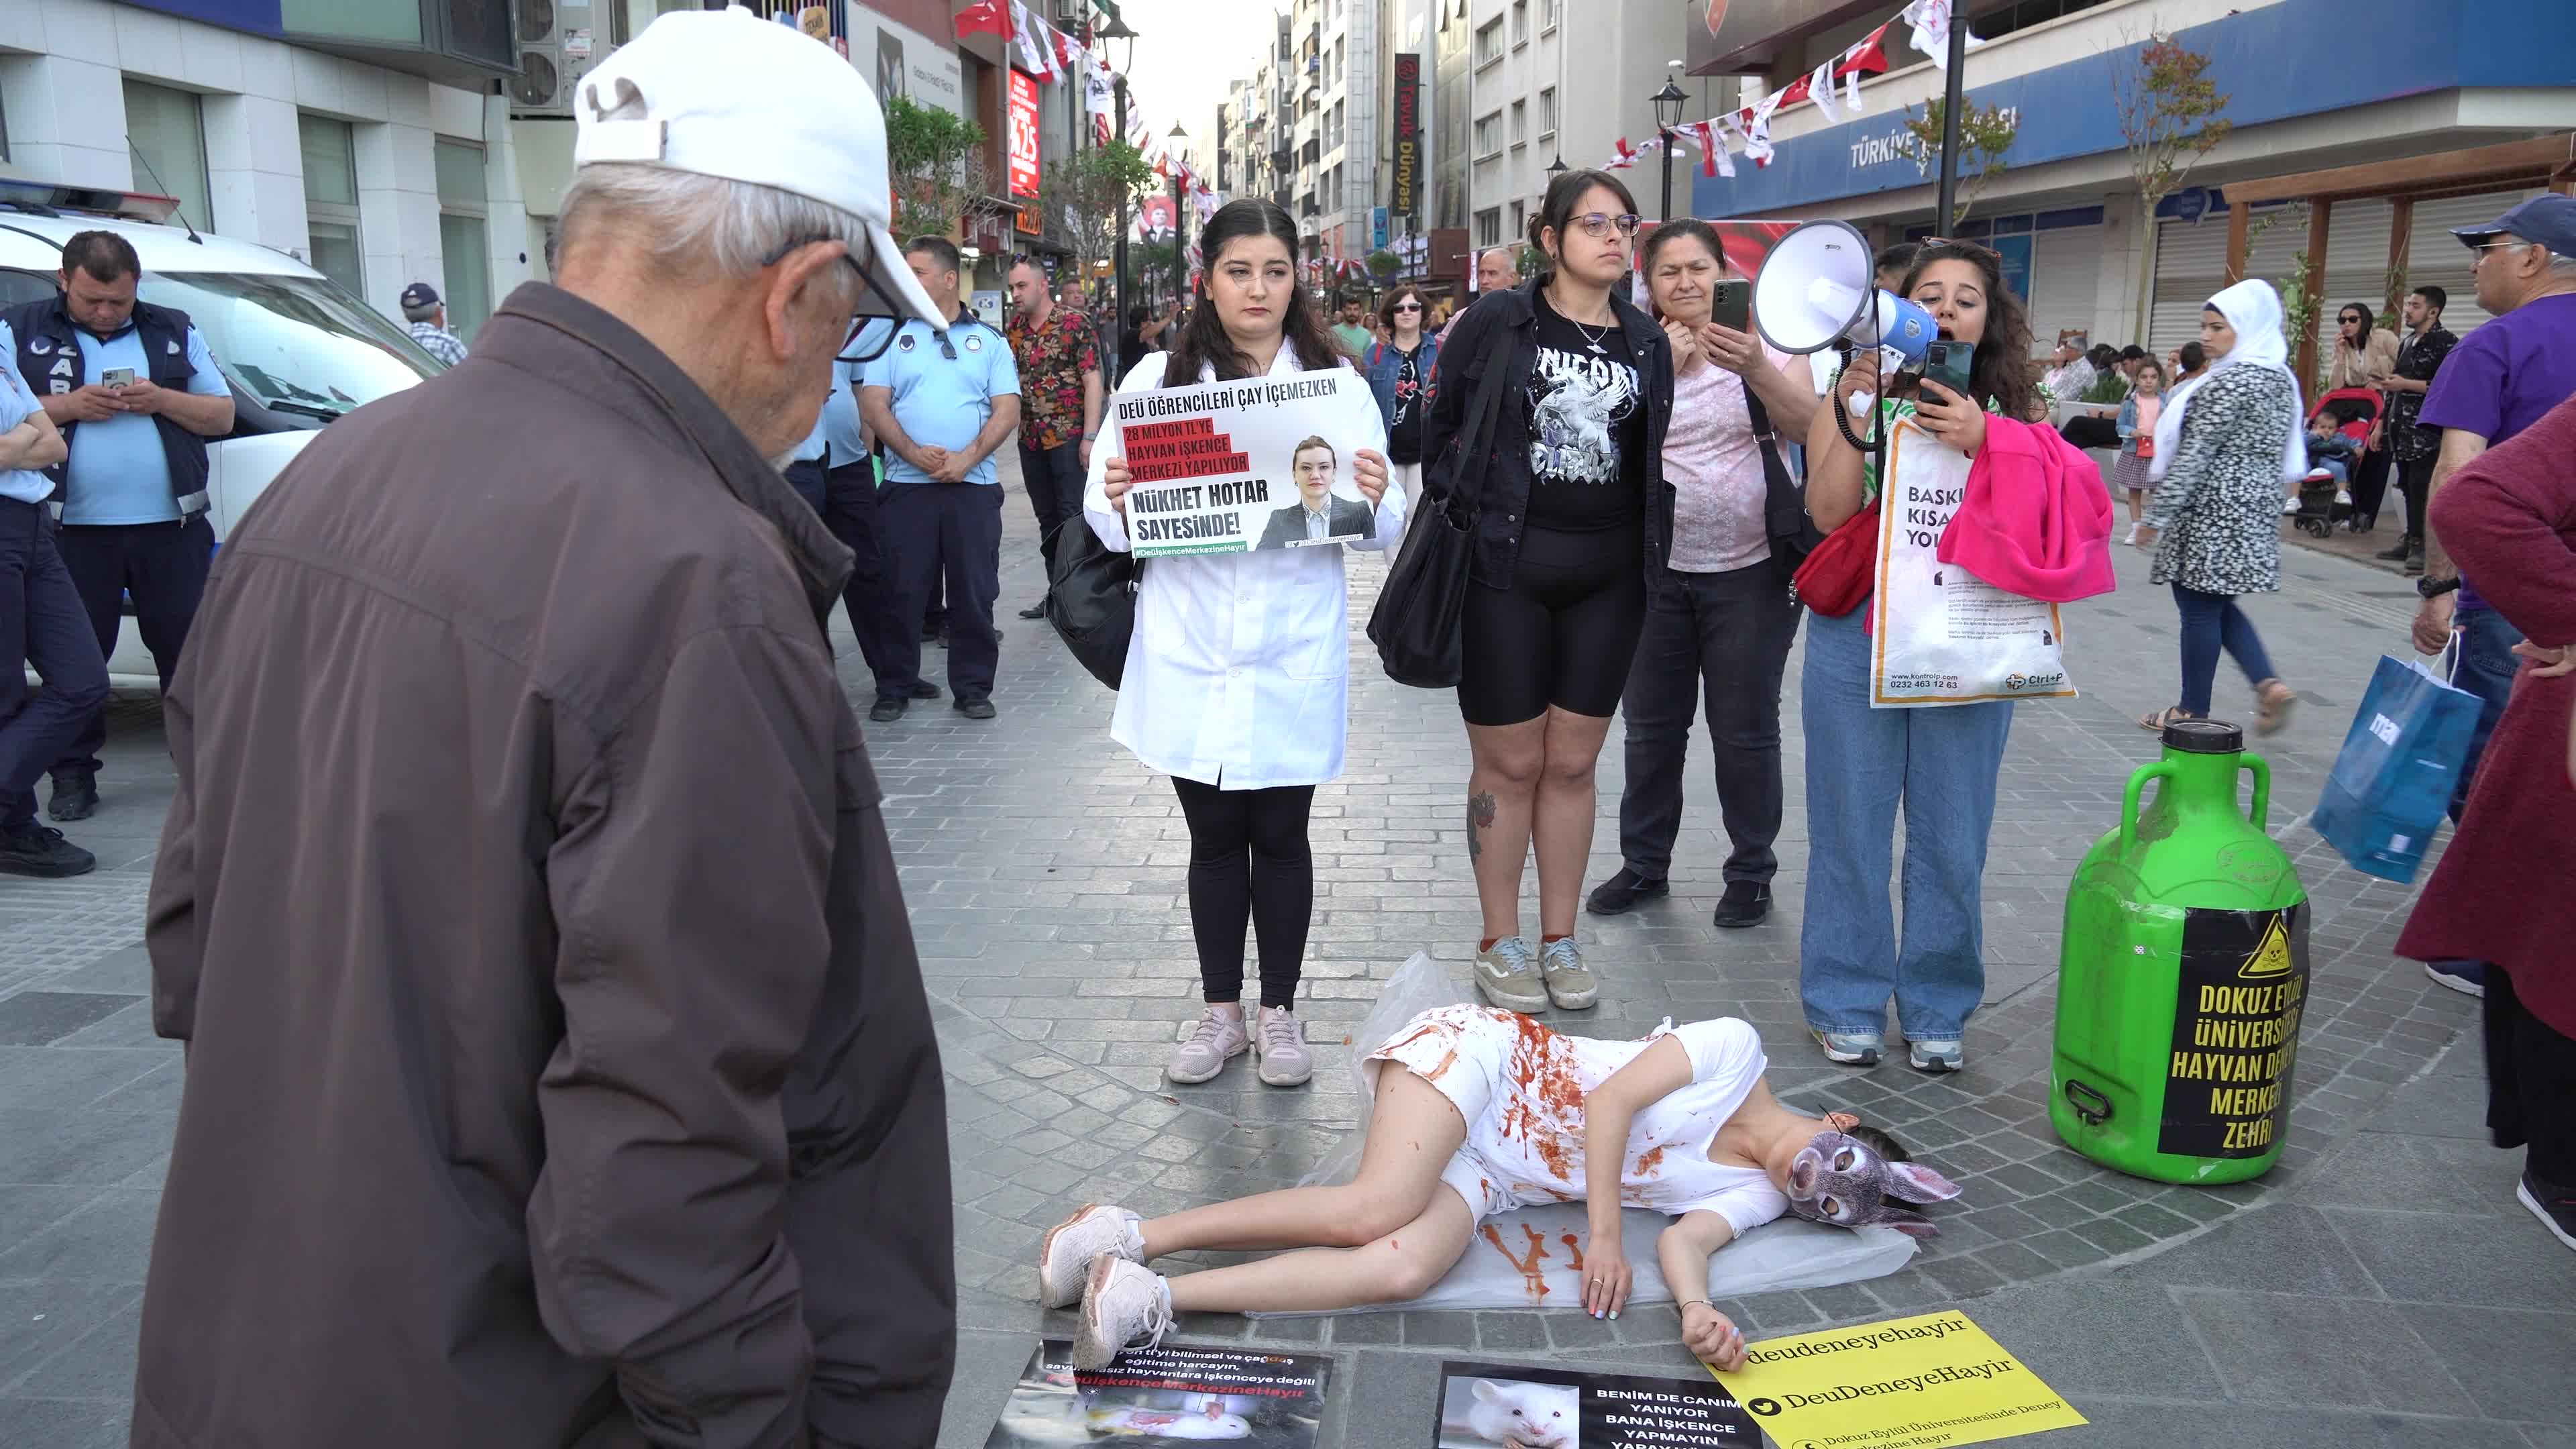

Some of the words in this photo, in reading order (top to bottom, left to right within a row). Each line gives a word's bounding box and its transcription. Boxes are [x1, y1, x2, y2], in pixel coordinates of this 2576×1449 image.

[1399, 85, 1415, 138] Tavuk
[1850, 128, 1915, 168] TÜRKİYE
[1397, 142, 1414, 211] Dünyası
[1119, 398, 1144, 419] DEÜ
[1147, 387, 1234, 417] ÖĞRENCİLERİ
[1238, 386, 1262, 412] ÇAY
[1265, 378, 1337, 408] İÇEMEZKEN
[1126, 428, 1140, 441] 28
[1142, 423, 1182, 440] MİLYON
[1185, 419, 1212, 435] TL'YE
[1128, 442, 1176, 462] HAYVAN
[1179, 437, 1229, 459] İŞKENCE
[1130, 461, 1183, 481] MERKEZİ
[1185, 455, 1247, 475] YAPILIYOR
[1132, 486, 1202, 513] NÜKHET
[1208, 479, 1269, 507] HOTAR
[1909, 486, 1963, 506] BASKI
[1136, 512, 1241, 541] SAYESİNDE!
[1907, 508, 1950, 527] KISA
[1890, 680, 1912, 689] 0232
[1915, 680, 1931, 688] 463
[1933, 680, 1943, 688] 12
[1946, 680, 1957, 690] 63
[1891, 672, 1958, 682] www.kontrolp.com
[2029, 672, 2063, 684] Ctrl+P
[2199, 985, 2272, 1014] DOKUZ
[2275, 974, 2302, 1012] EYLÜL
[2194, 1004, 2300, 1049] ÜNİVERSİTESİ
[2171, 1051, 2262, 1082] HAYVAN
[2210, 1079, 2282, 1116] MERKEZİ
[2222, 1116, 2274, 1149] ZEHRİ
[1748, 1318, 1967, 1366] deudeneyehayir
[1125, 1358, 1176, 1368] eğitime
[1179, 1360, 1240, 1371] harcayın,
[1171, 1350, 1224, 1360] bilimsel
[1244, 1354, 1294, 1364] çağdaş
[1127, 1366, 1201, 1379] hayvanlara
[1781, 1358, 2015, 1411] DeuDeneyeHayir
[1597, 1389, 1652, 1401] BENİM
[1656, 1393, 1680, 1403] DE
[1682, 1396, 1742, 1409] CANIM
[1630, 1403, 1709, 1417] YANIYOR
[1605, 1414, 1655, 1428] BANA
[1658, 1416, 1736, 1434] İŞKENCE
[1823, 1431, 1871, 1446] Dokuz
[1872, 1424, 1909, 1440] Eylül
[1910, 1406, 2018, 1434] Üniversitesinde
[2018, 1399, 2061, 1415] Deney
[1624, 1430, 1718, 1445] YAPMAYIN
[1850, 1439, 1911, 1449] rkezine
[1911, 1432, 1953, 1447] Hayır
